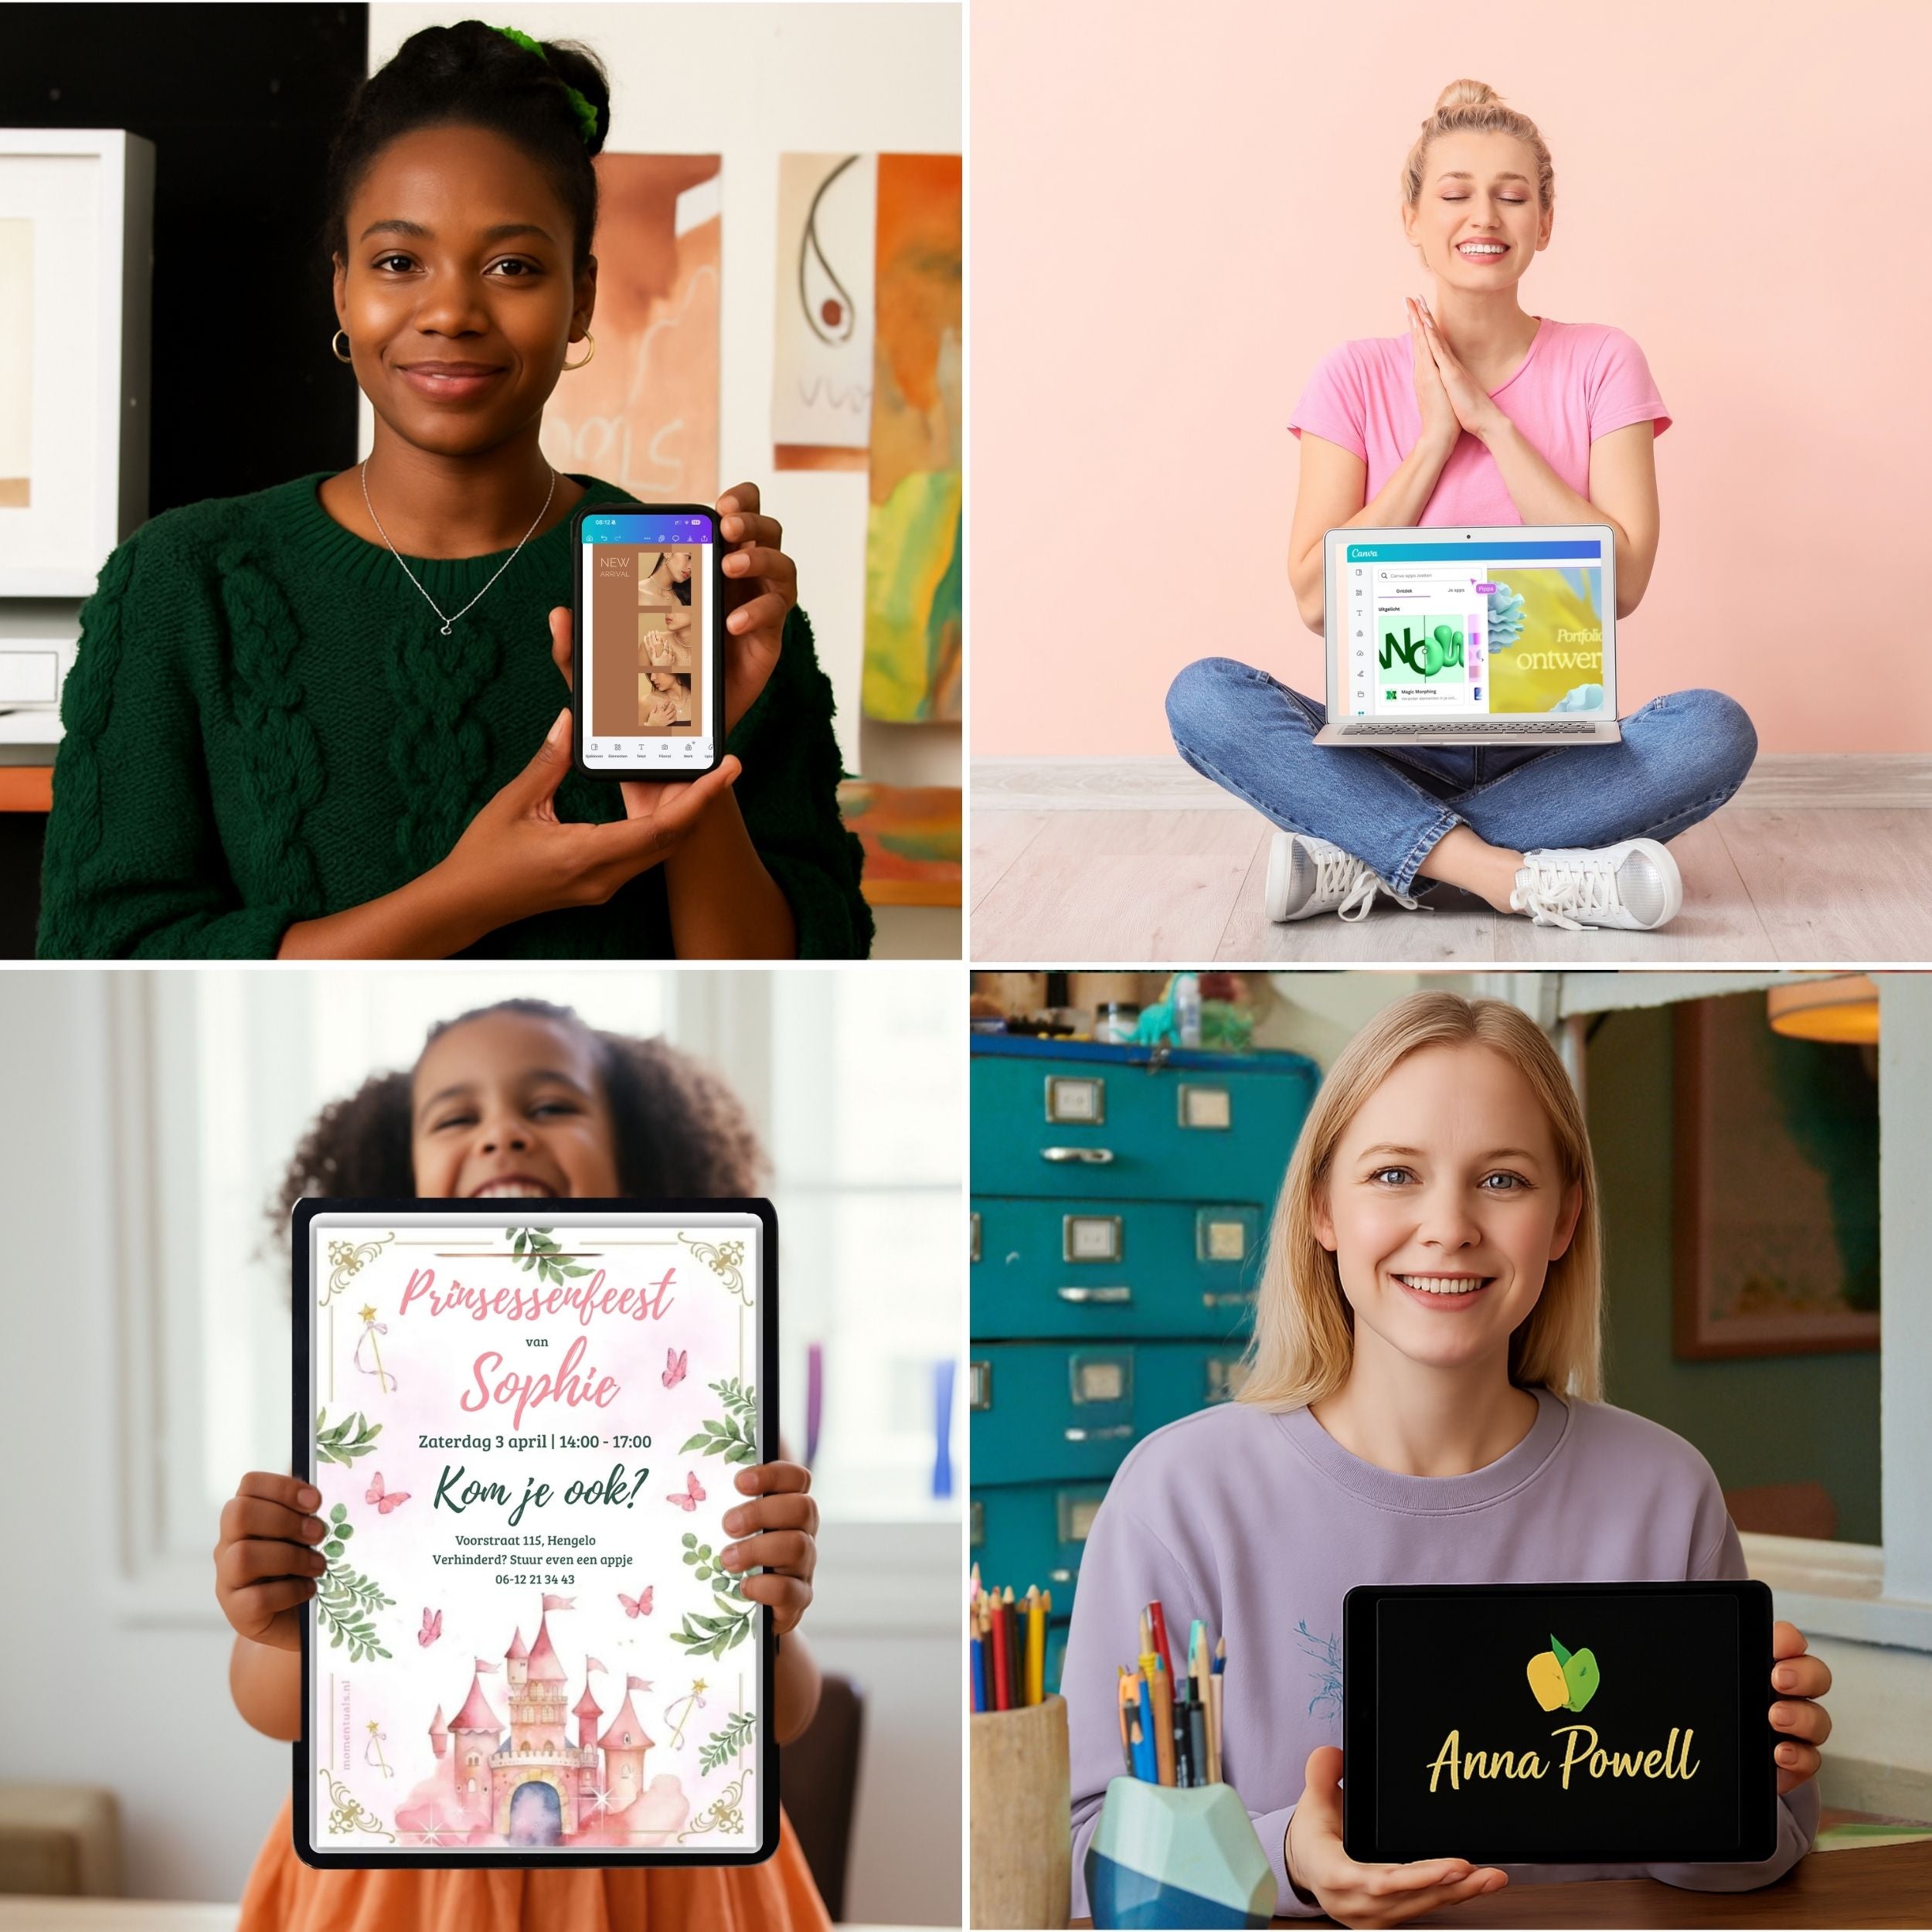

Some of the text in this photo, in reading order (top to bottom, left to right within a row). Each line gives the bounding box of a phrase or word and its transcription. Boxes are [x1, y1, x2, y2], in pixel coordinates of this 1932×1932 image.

[1352, 548, 1379, 558] Canva
[600, 557, 630, 568] NEW
[1516, 650, 1603, 675] ontwer
[399, 1266, 677, 1326] Prinsessenfeest
[525, 1338, 549, 1347] van
[460, 1335, 621, 1431] Sophie
[418, 1434, 492, 1452] Zaterdag
[495, 1435, 505, 1449] 3
[508, 1434, 547, 1452] april
[560, 1435, 600, 1449] 14:00
[612, 1435, 652, 1449] 17:00
[433, 1463, 650, 1527] Kom je ook?
[454, 1534, 597, 1549] Voorstraat 115, Hengelo
[432, 1554, 633, 1568] Verhinderd? Stuur even een appje
[495, 1574, 575, 1585] 06-12 21 34 43
[342, 1681, 350, 1770] momentuals.nl
[1426, 1724, 1701, 1793] Anna Powell
